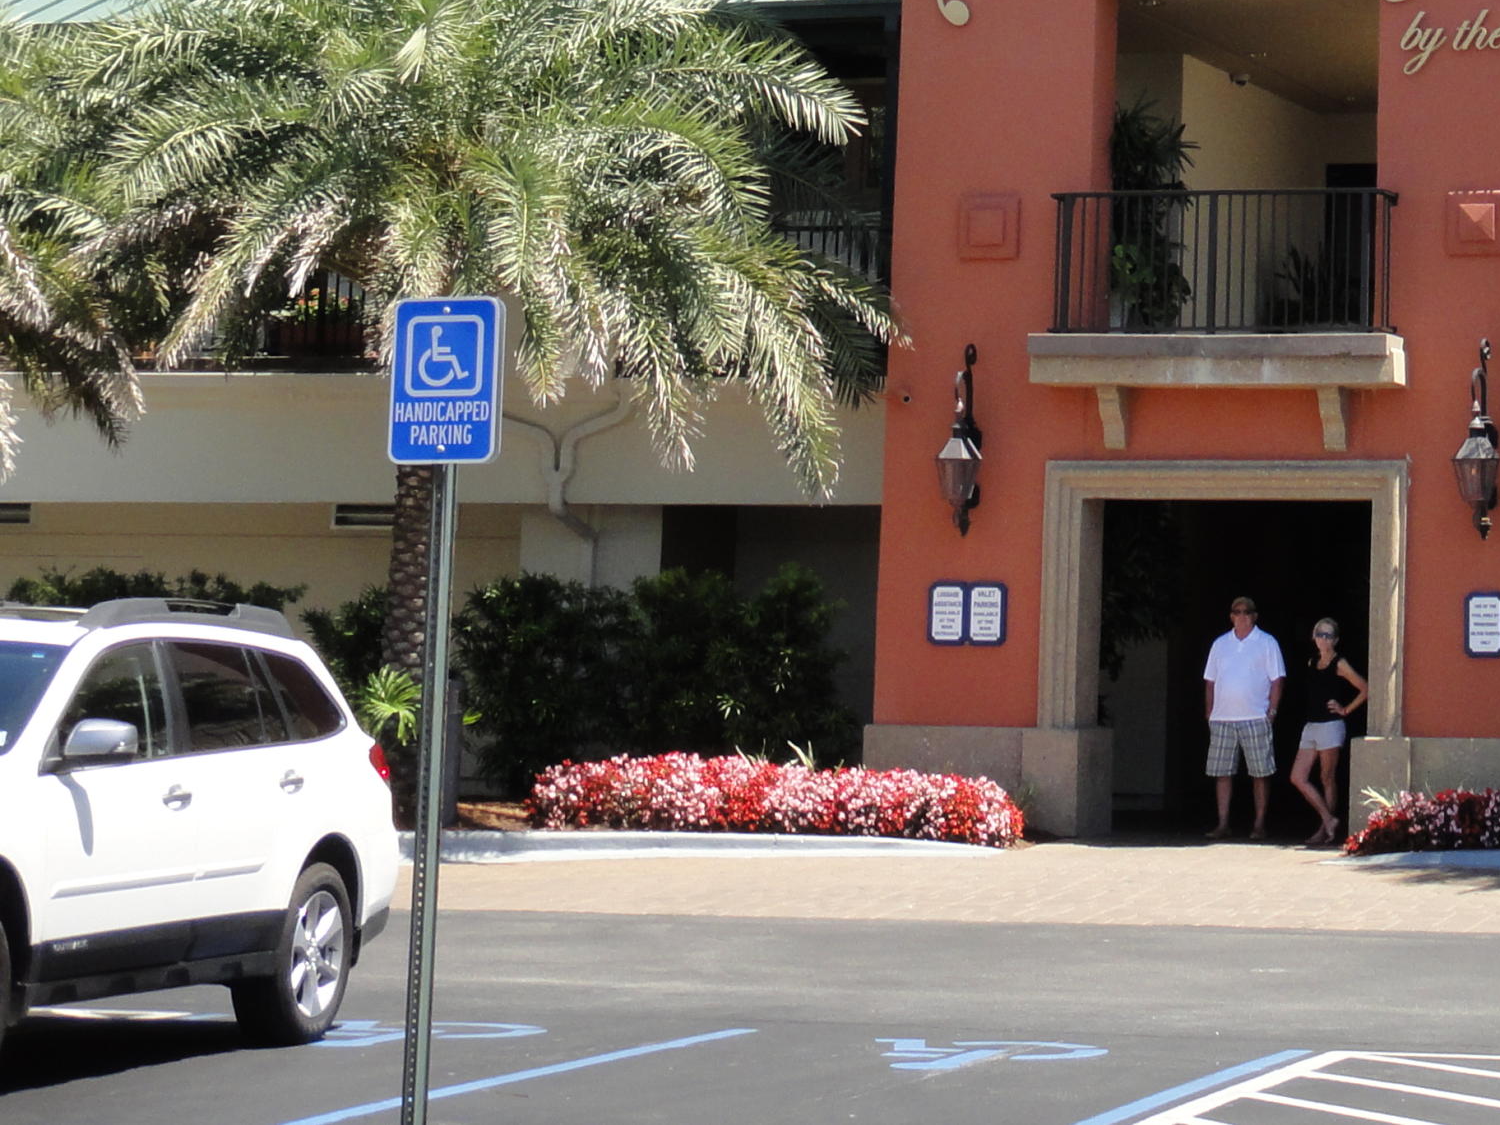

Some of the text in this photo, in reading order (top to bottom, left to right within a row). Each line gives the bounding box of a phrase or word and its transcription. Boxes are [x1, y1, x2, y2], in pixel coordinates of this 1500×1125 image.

[1400, 10, 1447, 75] by
[394, 400, 490, 423] HANDICAPPED
[410, 425, 473, 446] PARKING
